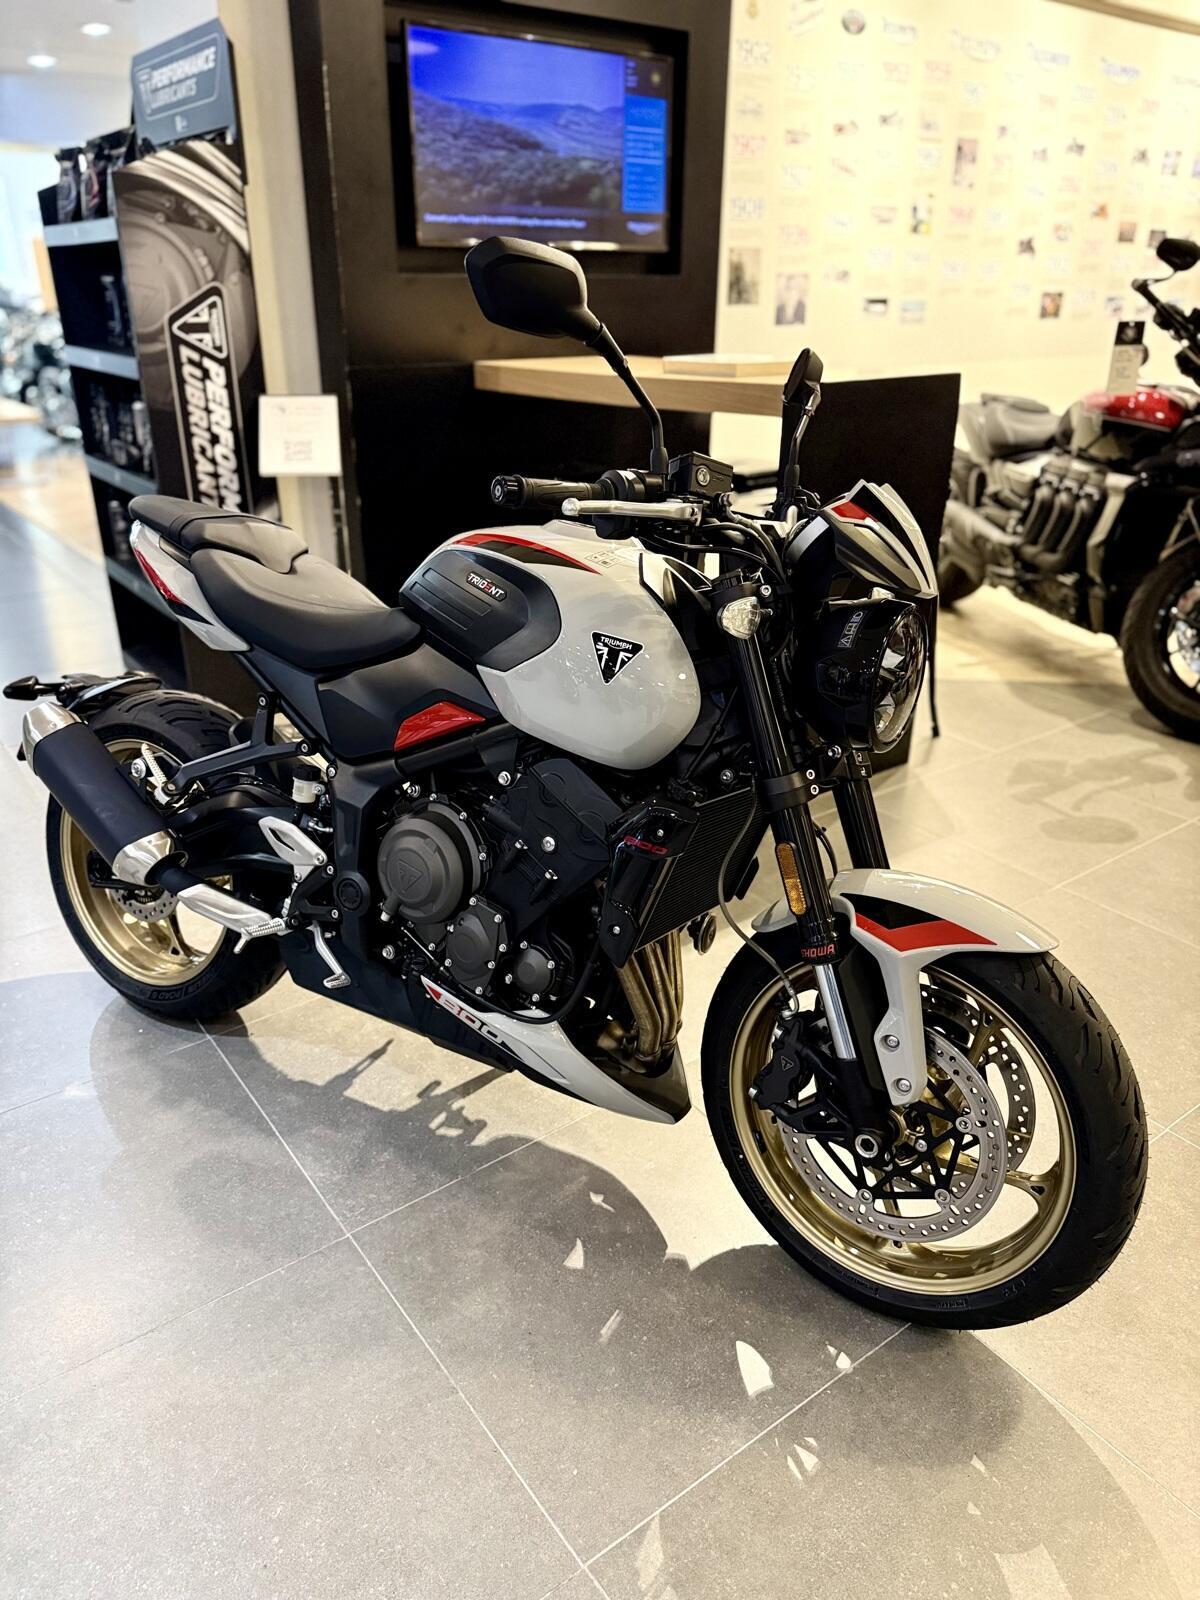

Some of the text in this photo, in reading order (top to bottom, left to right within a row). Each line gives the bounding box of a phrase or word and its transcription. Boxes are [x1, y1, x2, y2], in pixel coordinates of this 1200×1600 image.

[150, 46, 217, 91] PERFORMANCE
[468, 573, 505, 597] TRIDENT
[600, 636, 632, 650] TRIUMPH
[801, 944, 836, 958] SHOWA
